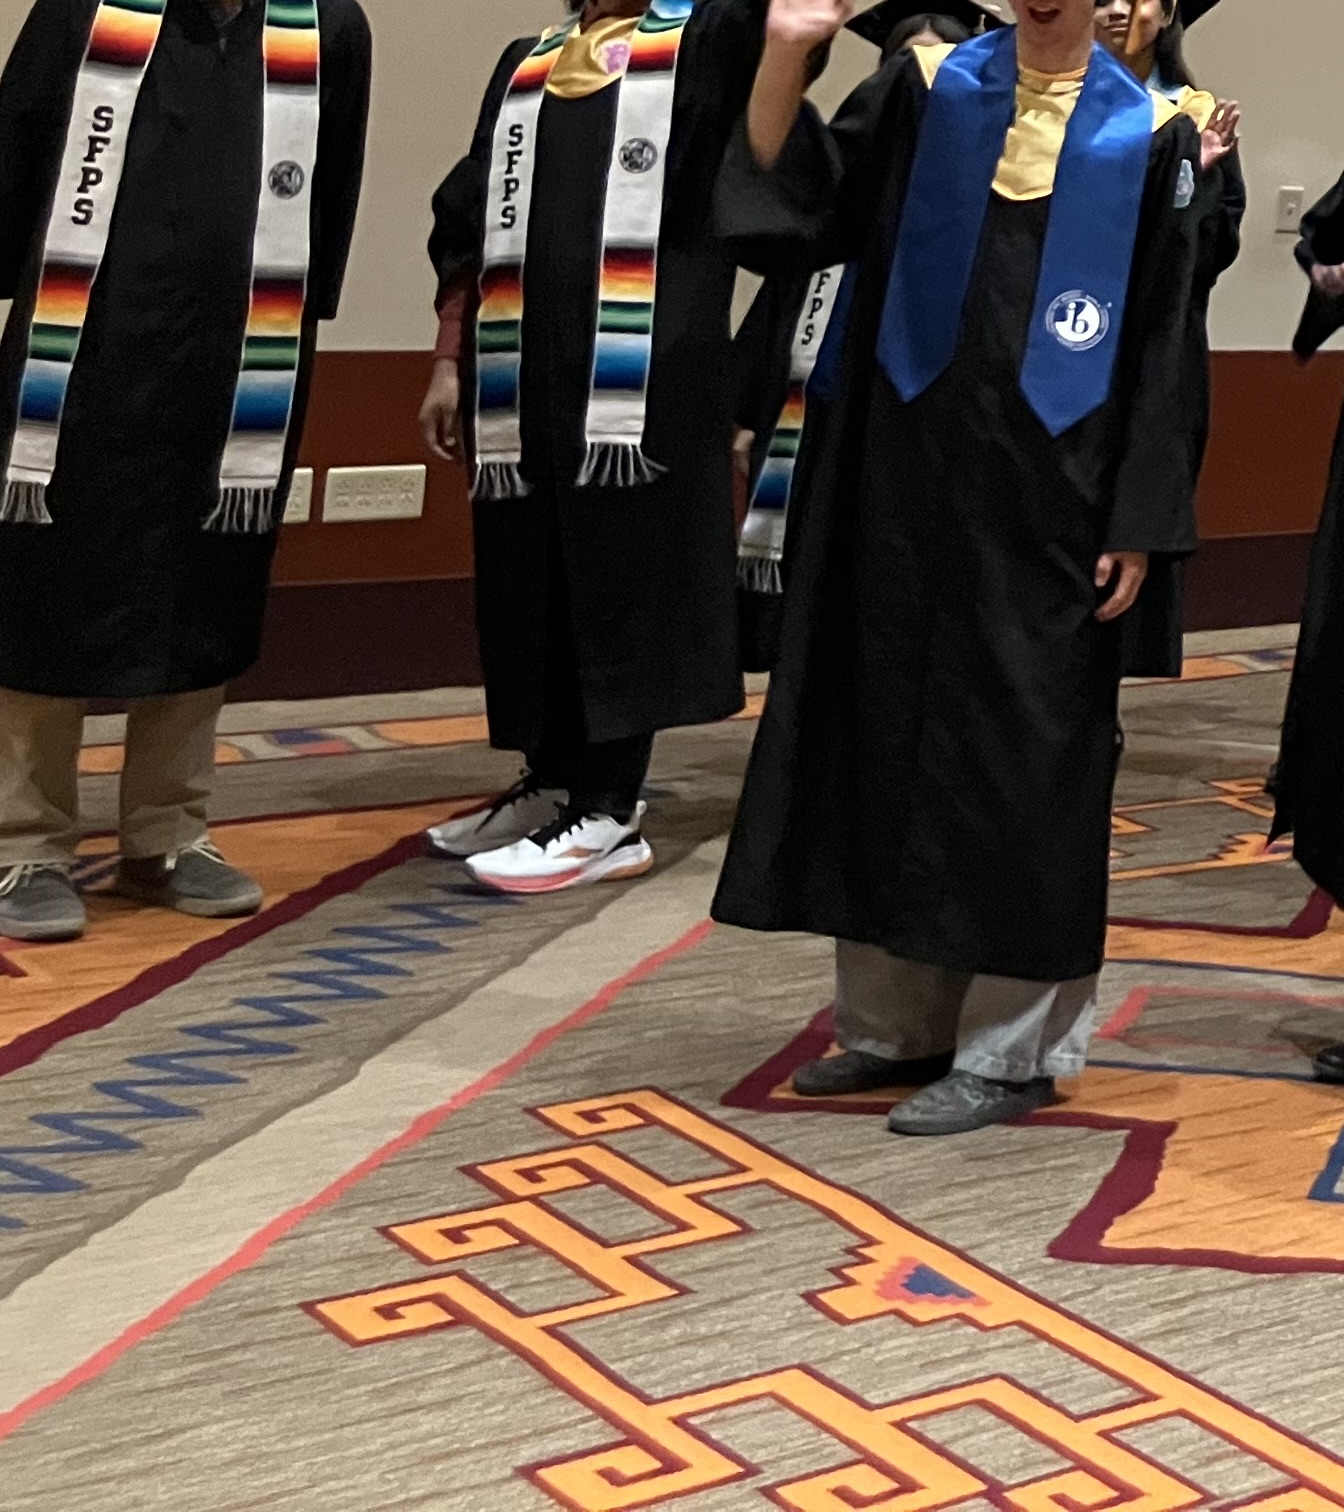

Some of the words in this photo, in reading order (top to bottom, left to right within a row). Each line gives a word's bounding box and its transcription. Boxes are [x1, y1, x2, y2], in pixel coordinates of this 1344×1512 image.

[71, 105, 114, 226] SFPS
[500, 123, 524, 229] SFPS
[801, 271, 831, 346] FPS
